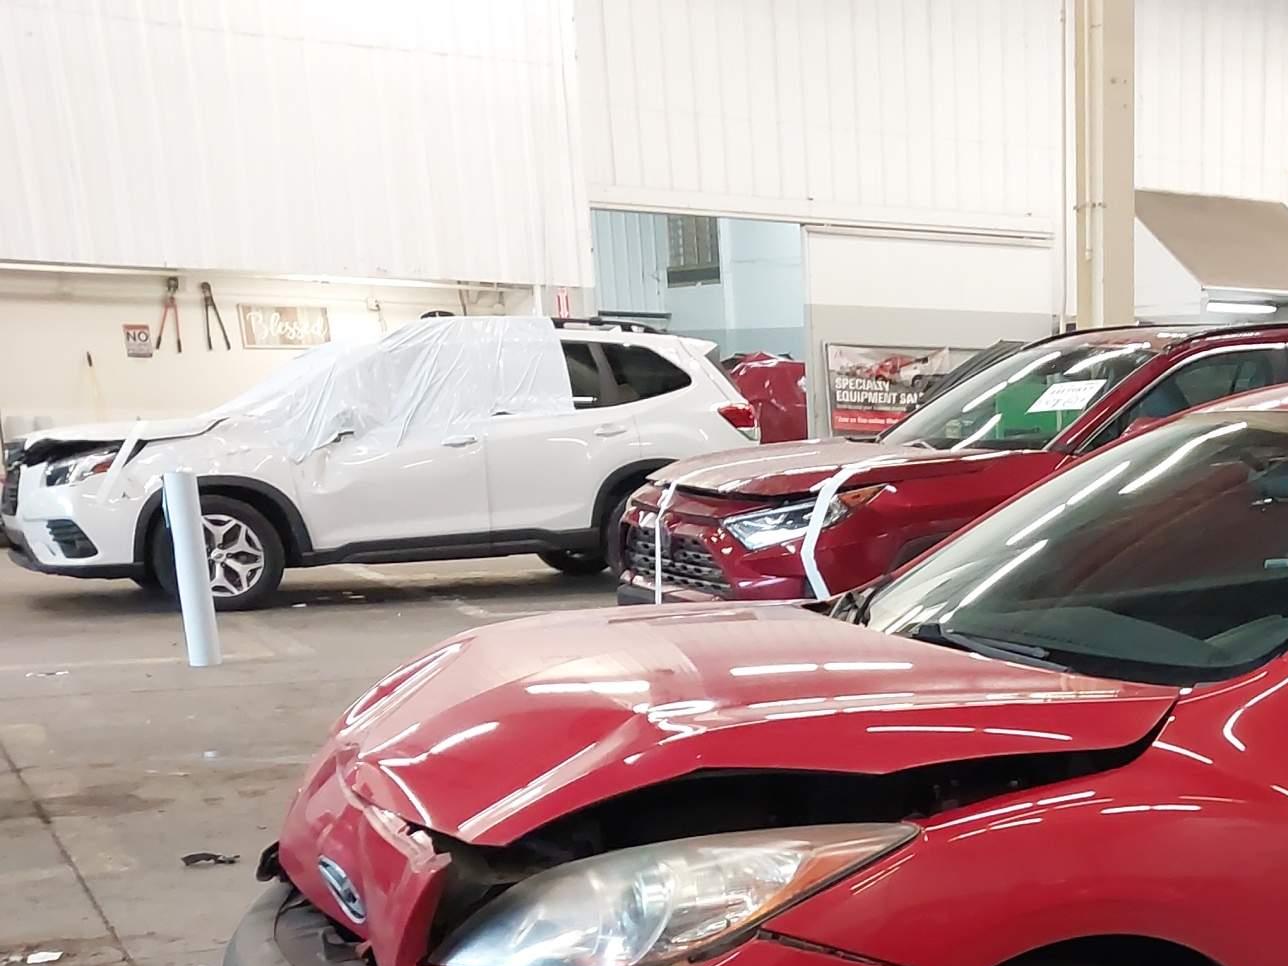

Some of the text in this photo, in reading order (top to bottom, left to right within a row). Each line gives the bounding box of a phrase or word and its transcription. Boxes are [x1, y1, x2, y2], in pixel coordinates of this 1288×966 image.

[246, 312, 329, 340] Blessed
[126, 330, 149, 343] NO
[835, 377, 890, 392] SPECIALTY
[836, 391, 898, 404] EQUIPMENT
